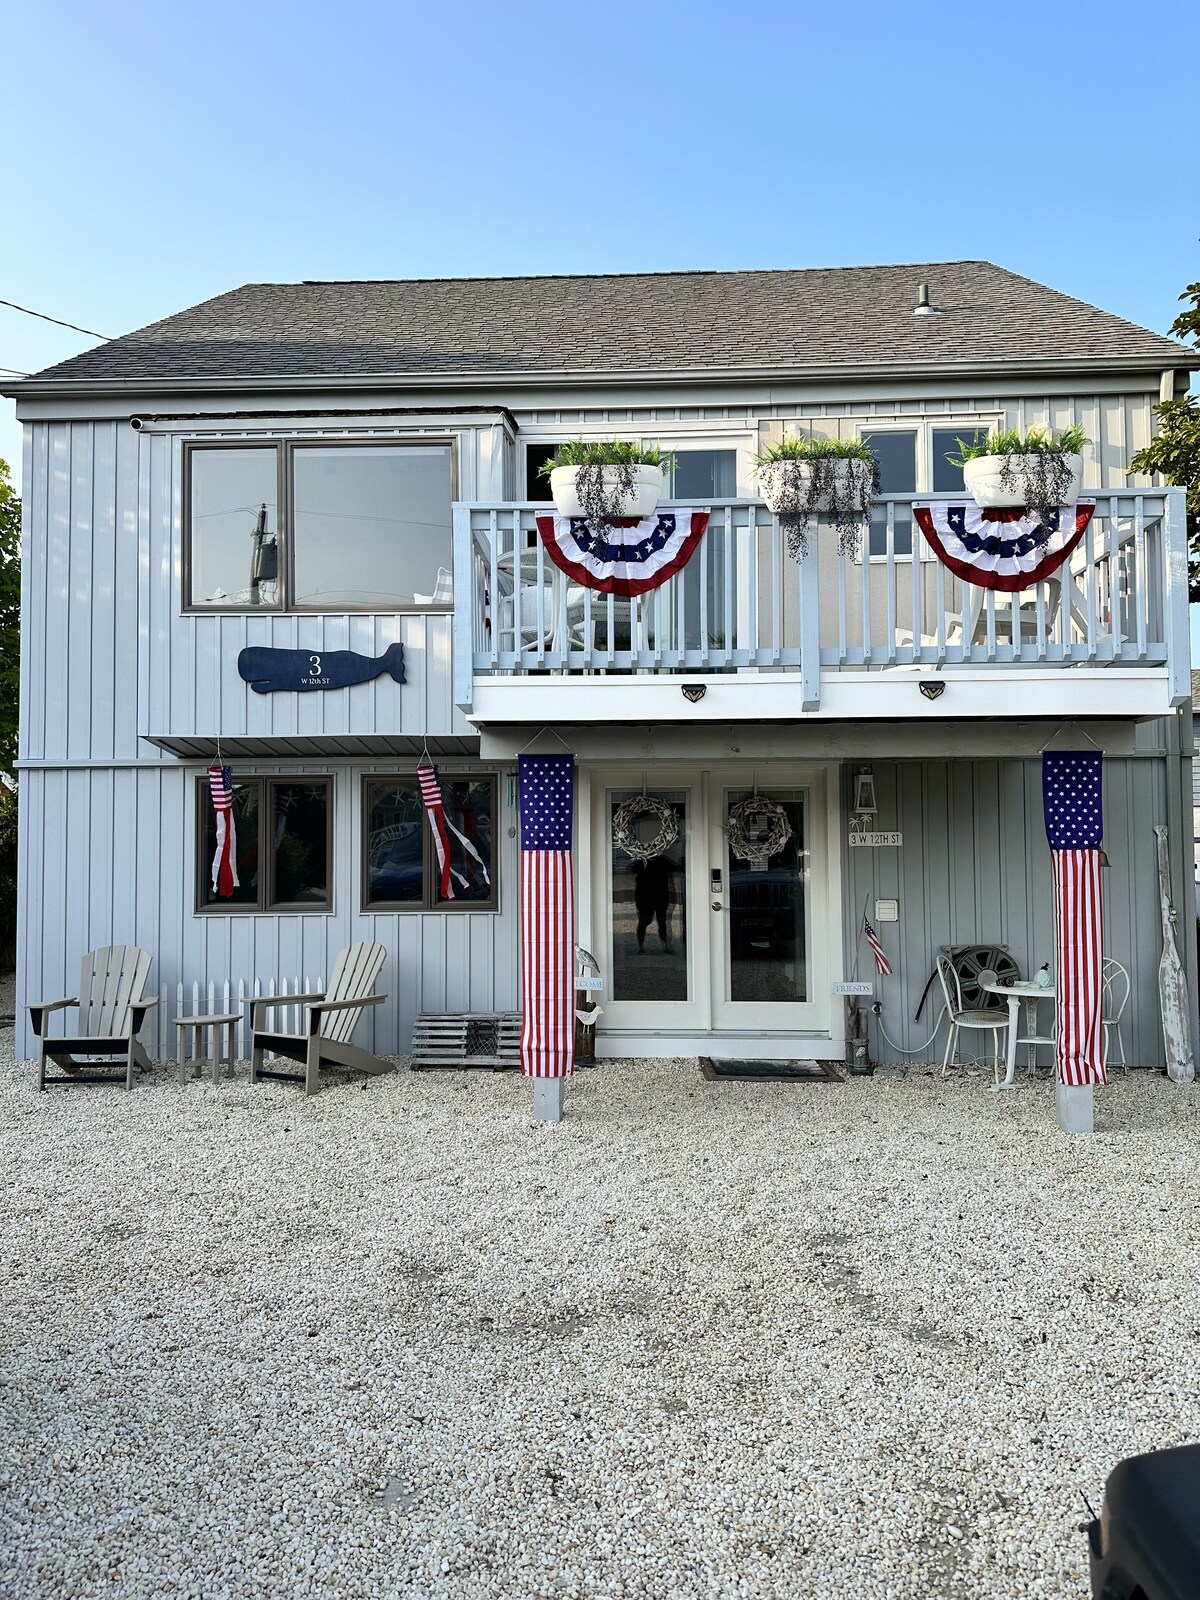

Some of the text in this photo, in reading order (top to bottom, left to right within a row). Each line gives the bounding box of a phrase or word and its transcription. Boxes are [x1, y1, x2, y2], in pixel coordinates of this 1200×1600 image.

[309, 655, 322, 676] 3
[309, 677, 321, 685] 12th
[322, 677, 331, 685] ST
[851, 834, 900, 845] 3 W 12TH ST
[575, 980, 604, 988] LCOME
